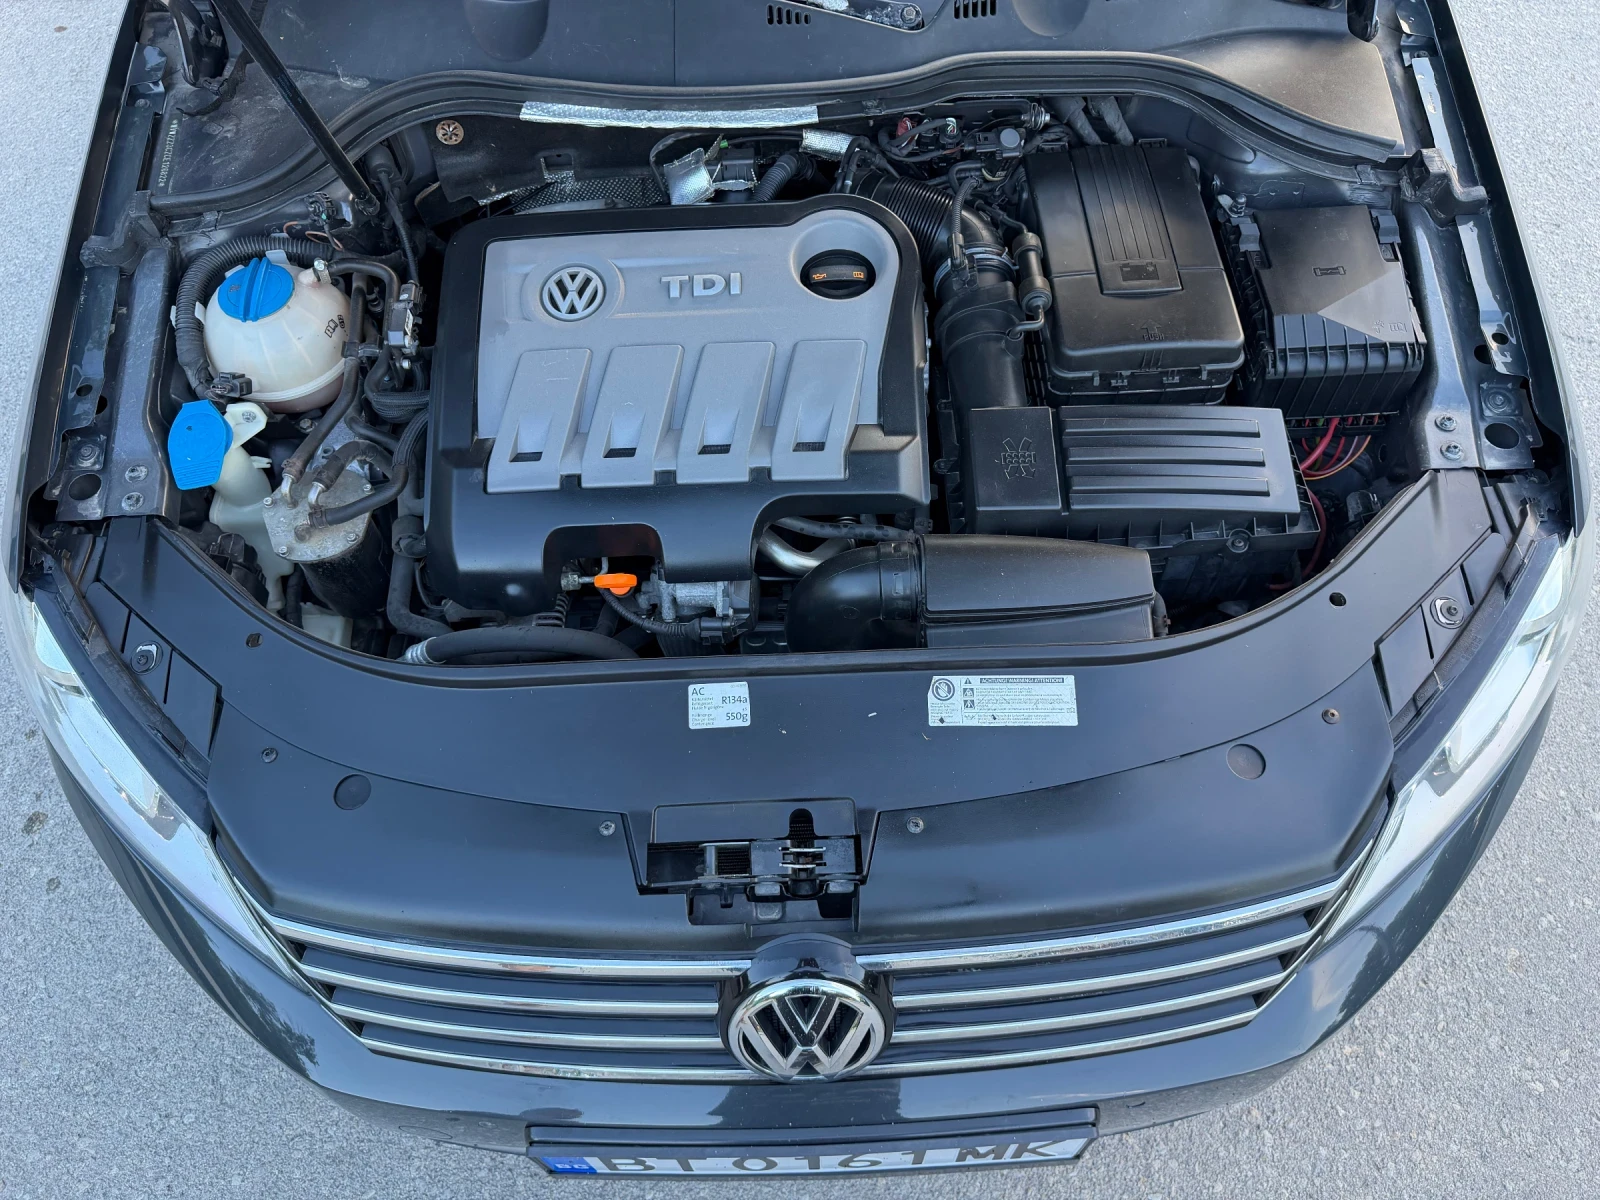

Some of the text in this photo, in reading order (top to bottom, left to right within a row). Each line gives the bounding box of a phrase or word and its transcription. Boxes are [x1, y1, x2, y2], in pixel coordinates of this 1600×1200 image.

[660, 272, 742, 299] TDI
[691, 687, 705, 696] AC
[721, 695, 748, 705] R134a
[726, 712, 748, 723] 550g
[732, 1150, 927, 1172] 0161
[955, 1140, 1070, 1162] MK
